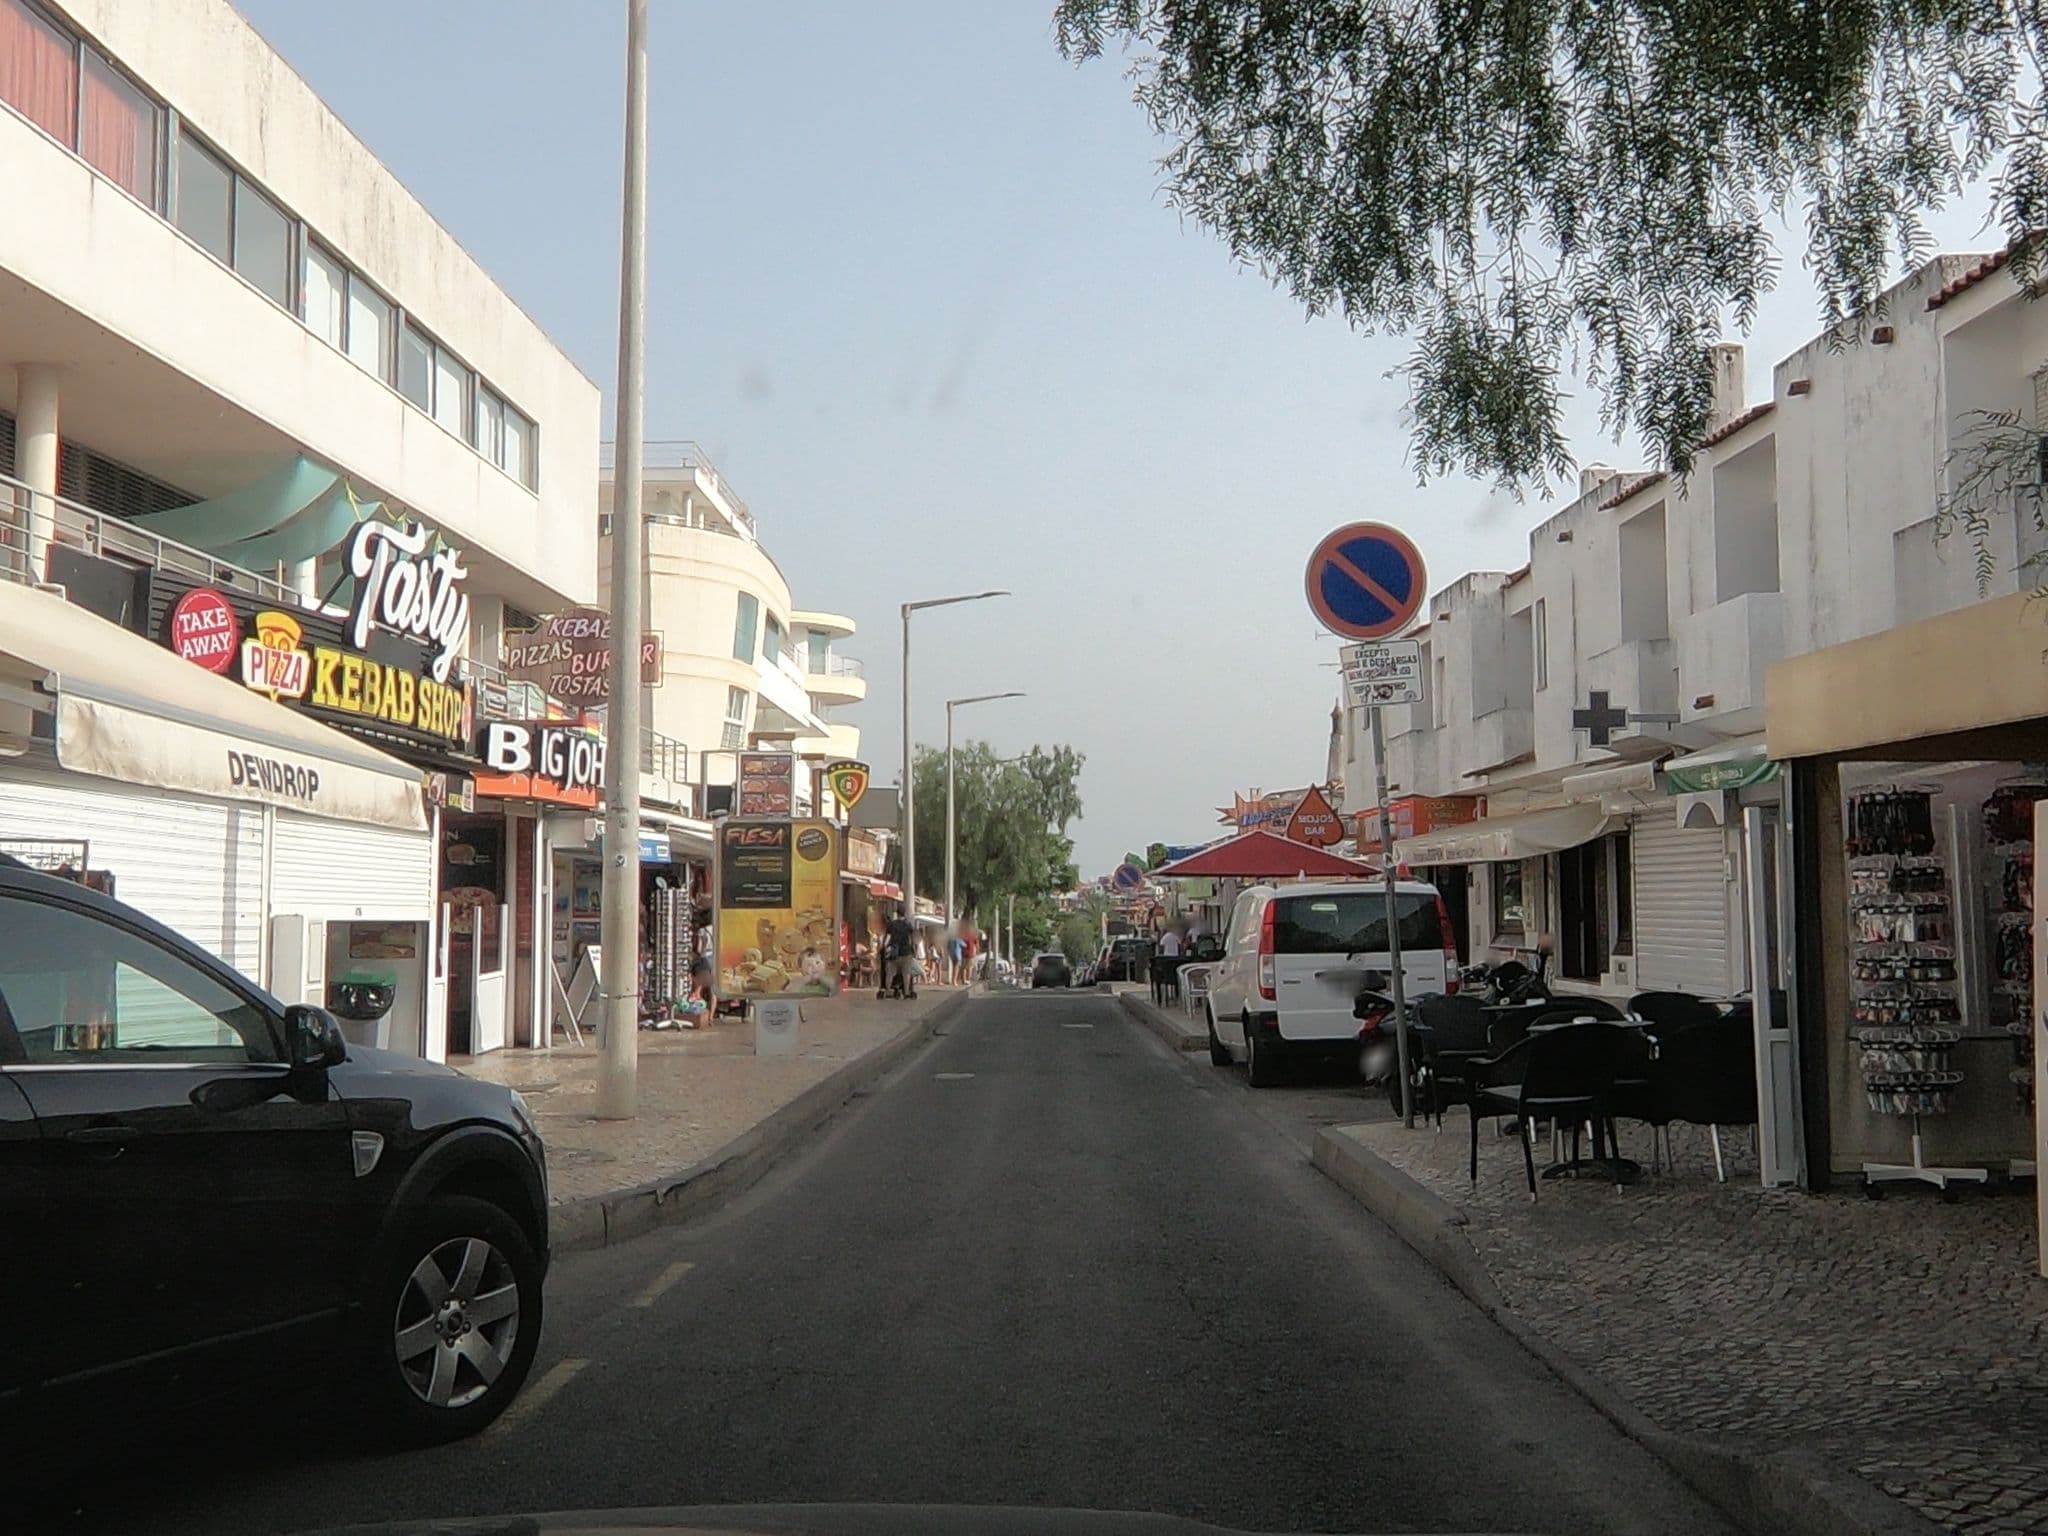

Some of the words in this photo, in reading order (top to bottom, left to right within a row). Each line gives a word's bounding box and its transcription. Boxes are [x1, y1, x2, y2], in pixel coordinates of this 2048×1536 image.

[352, 520, 468, 682] Tasty
[178, 607, 229, 633] TAKE
[180, 632, 231, 659] AWAY
[509, 640, 573, 669] PIZZAS
[1354, 648, 1390, 659] EXCEPTO
[250, 646, 303, 690] PIZZA
[312, 646, 415, 725] KEBAB
[417, 676, 463, 738] SHOP
[227, 749, 320, 801] DEWDROP
[1304, 826, 1326, 836] BAR
